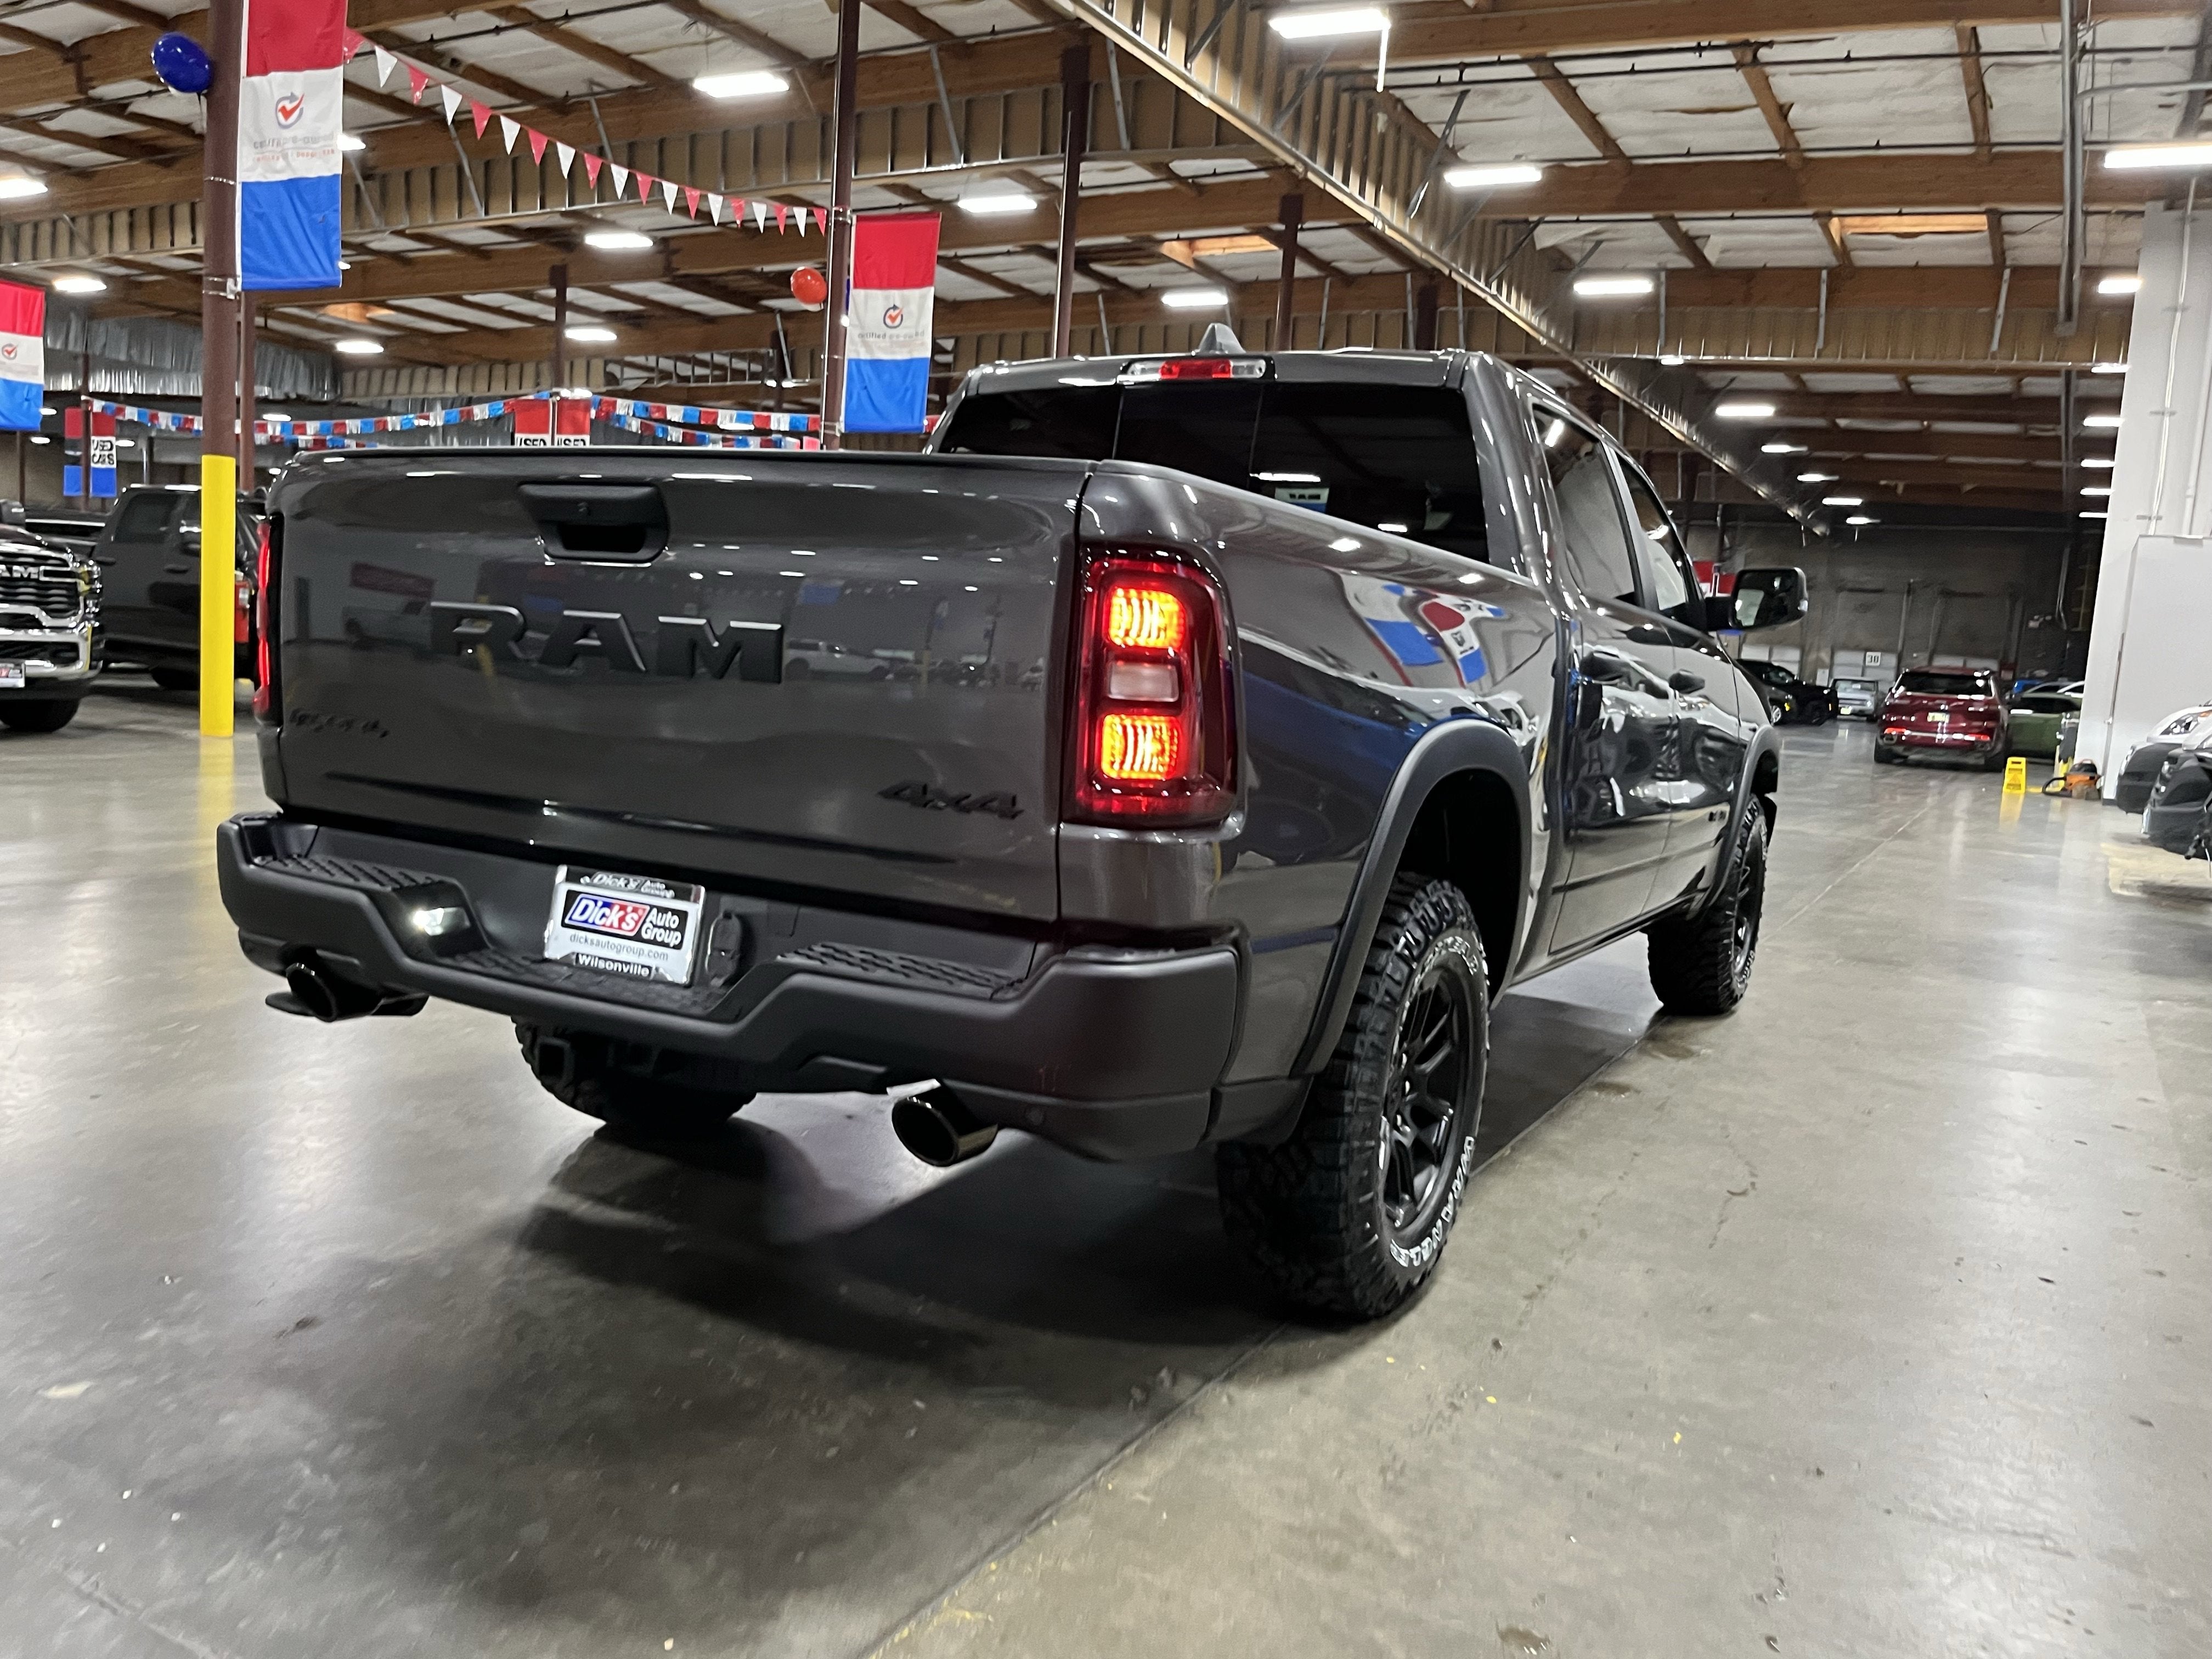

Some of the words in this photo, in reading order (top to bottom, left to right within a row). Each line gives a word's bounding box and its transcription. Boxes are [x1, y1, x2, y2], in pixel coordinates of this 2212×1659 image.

[0, 564, 38, 579] AM
[430, 601, 783, 684] RAM
[571, 899, 639, 931] Dick's
[646, 907, 680, 929] Auto
[569, 933, 669, 961] dicksautogroup.com
[641, 923, 682, 947] Group
[578, 953, 650, 977] Wilsonville
